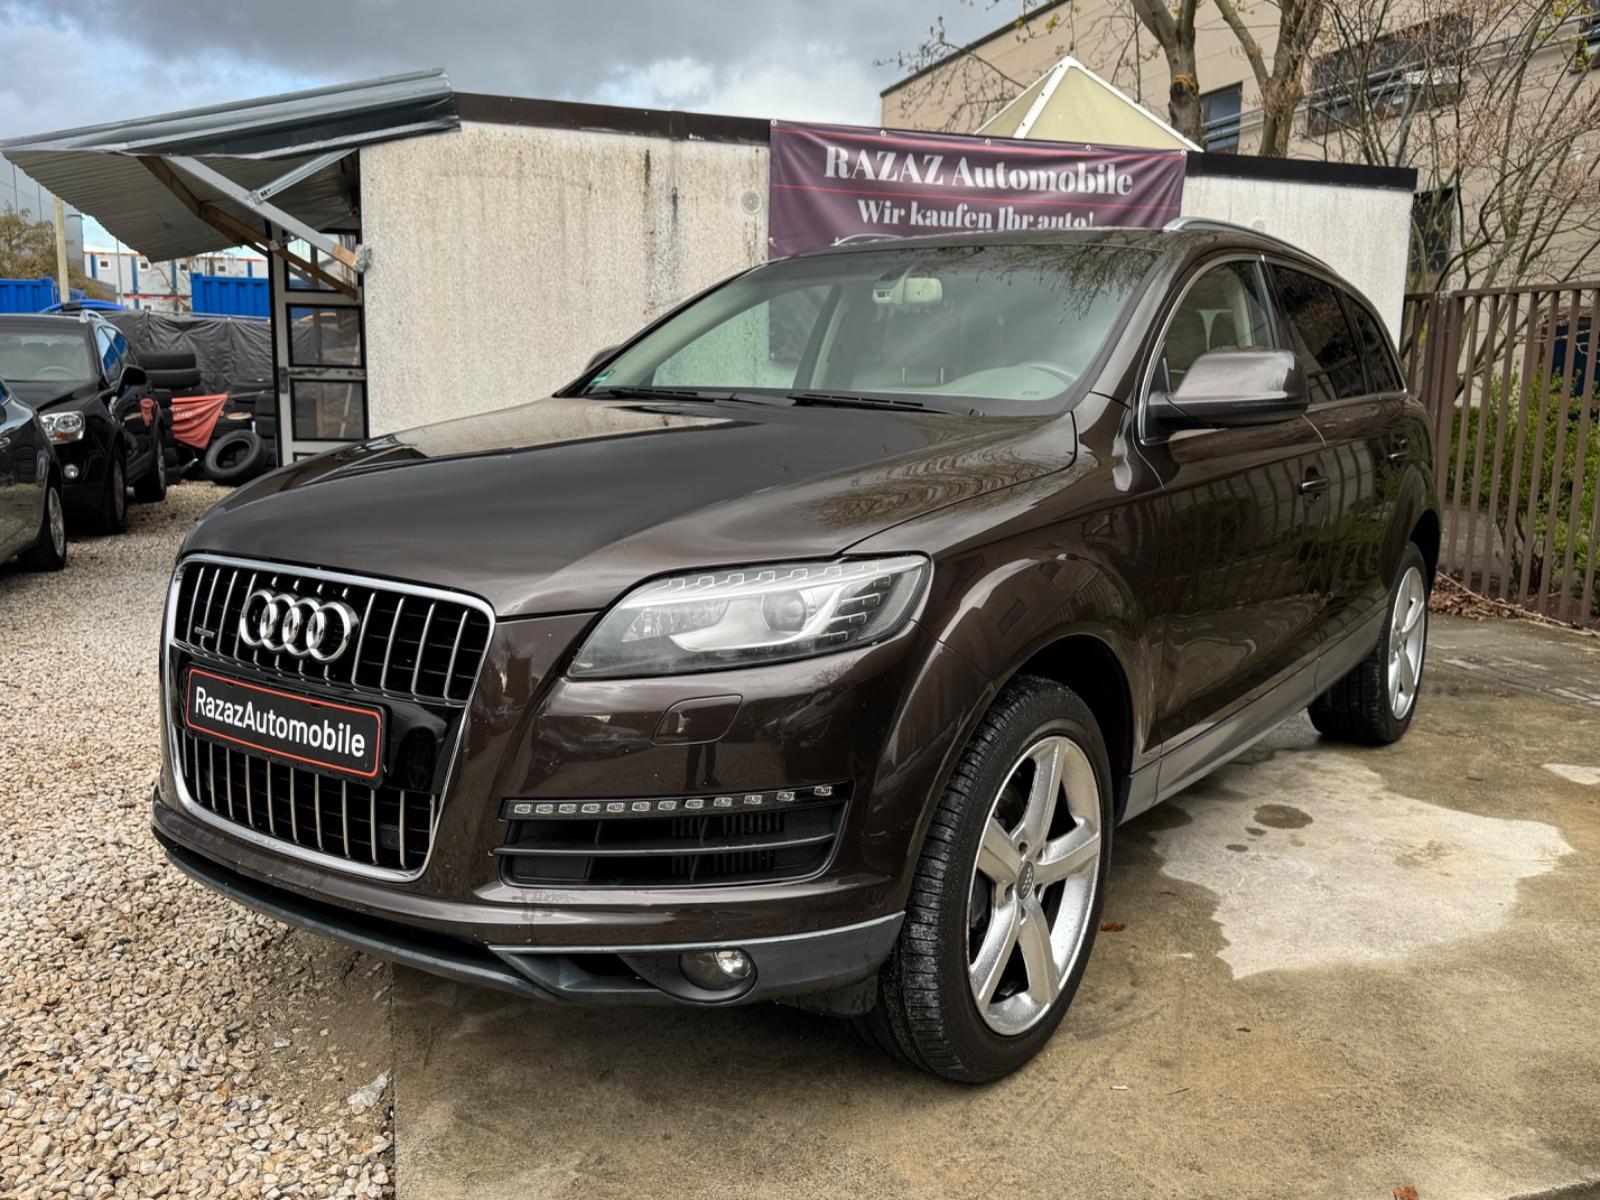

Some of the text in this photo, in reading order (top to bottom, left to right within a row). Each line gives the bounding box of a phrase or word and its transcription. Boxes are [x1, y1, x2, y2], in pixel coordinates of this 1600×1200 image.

[824, 146, 1133, 196] RAZAZ Automobile
[857, 199, 906, 225] Wir
[910, 201, 992, 229] kaufen
[998, 206, 1034, 231] Ihr
[195, 686, 365, 757] RazazAutomobile
